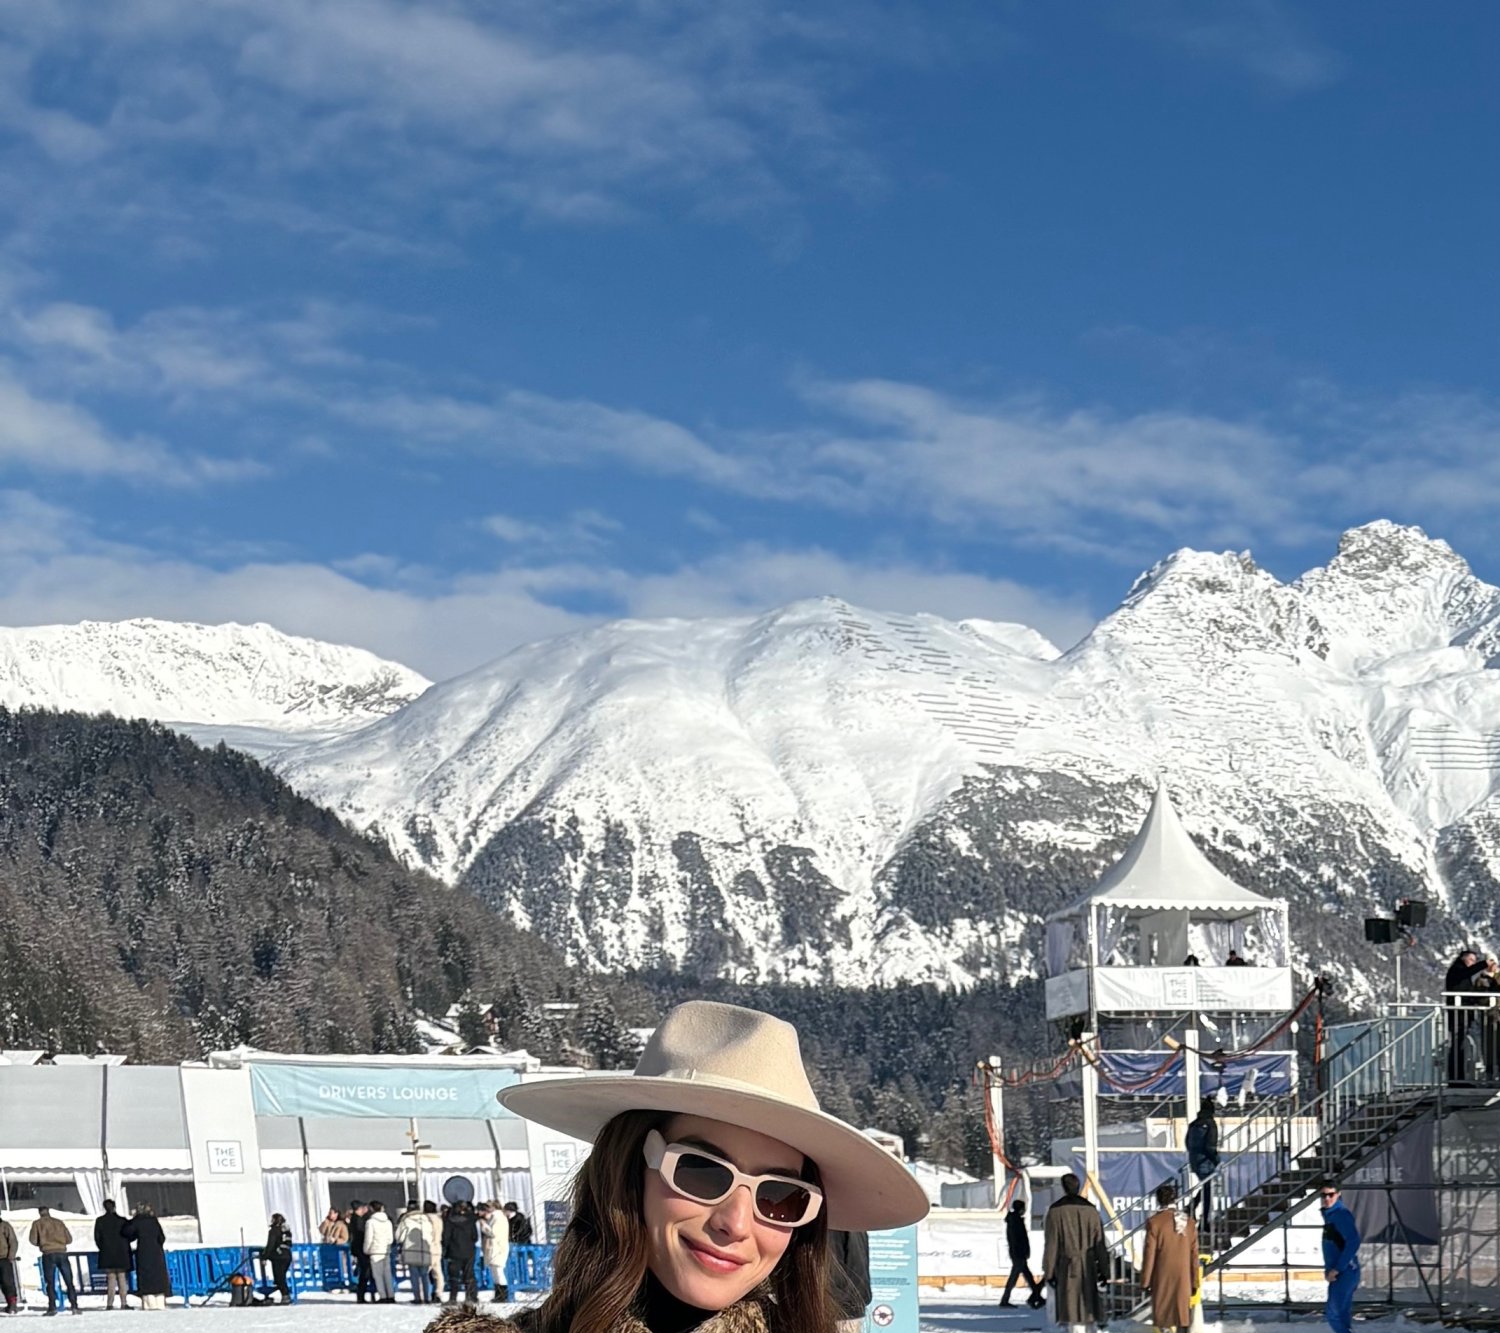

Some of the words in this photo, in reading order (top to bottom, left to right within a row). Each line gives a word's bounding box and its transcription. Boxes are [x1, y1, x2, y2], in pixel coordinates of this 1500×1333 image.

[319, 1085, 390, 1100] DRIVERS'
[393, 1086, 458, 1101] LOUNGE
[214, 1147, 235, 1157] THE
[551, 1149, 570, 1158] THE
[217, 1158, 237, 1168] ICE
[552, 1160, 570, 1168] ICE
